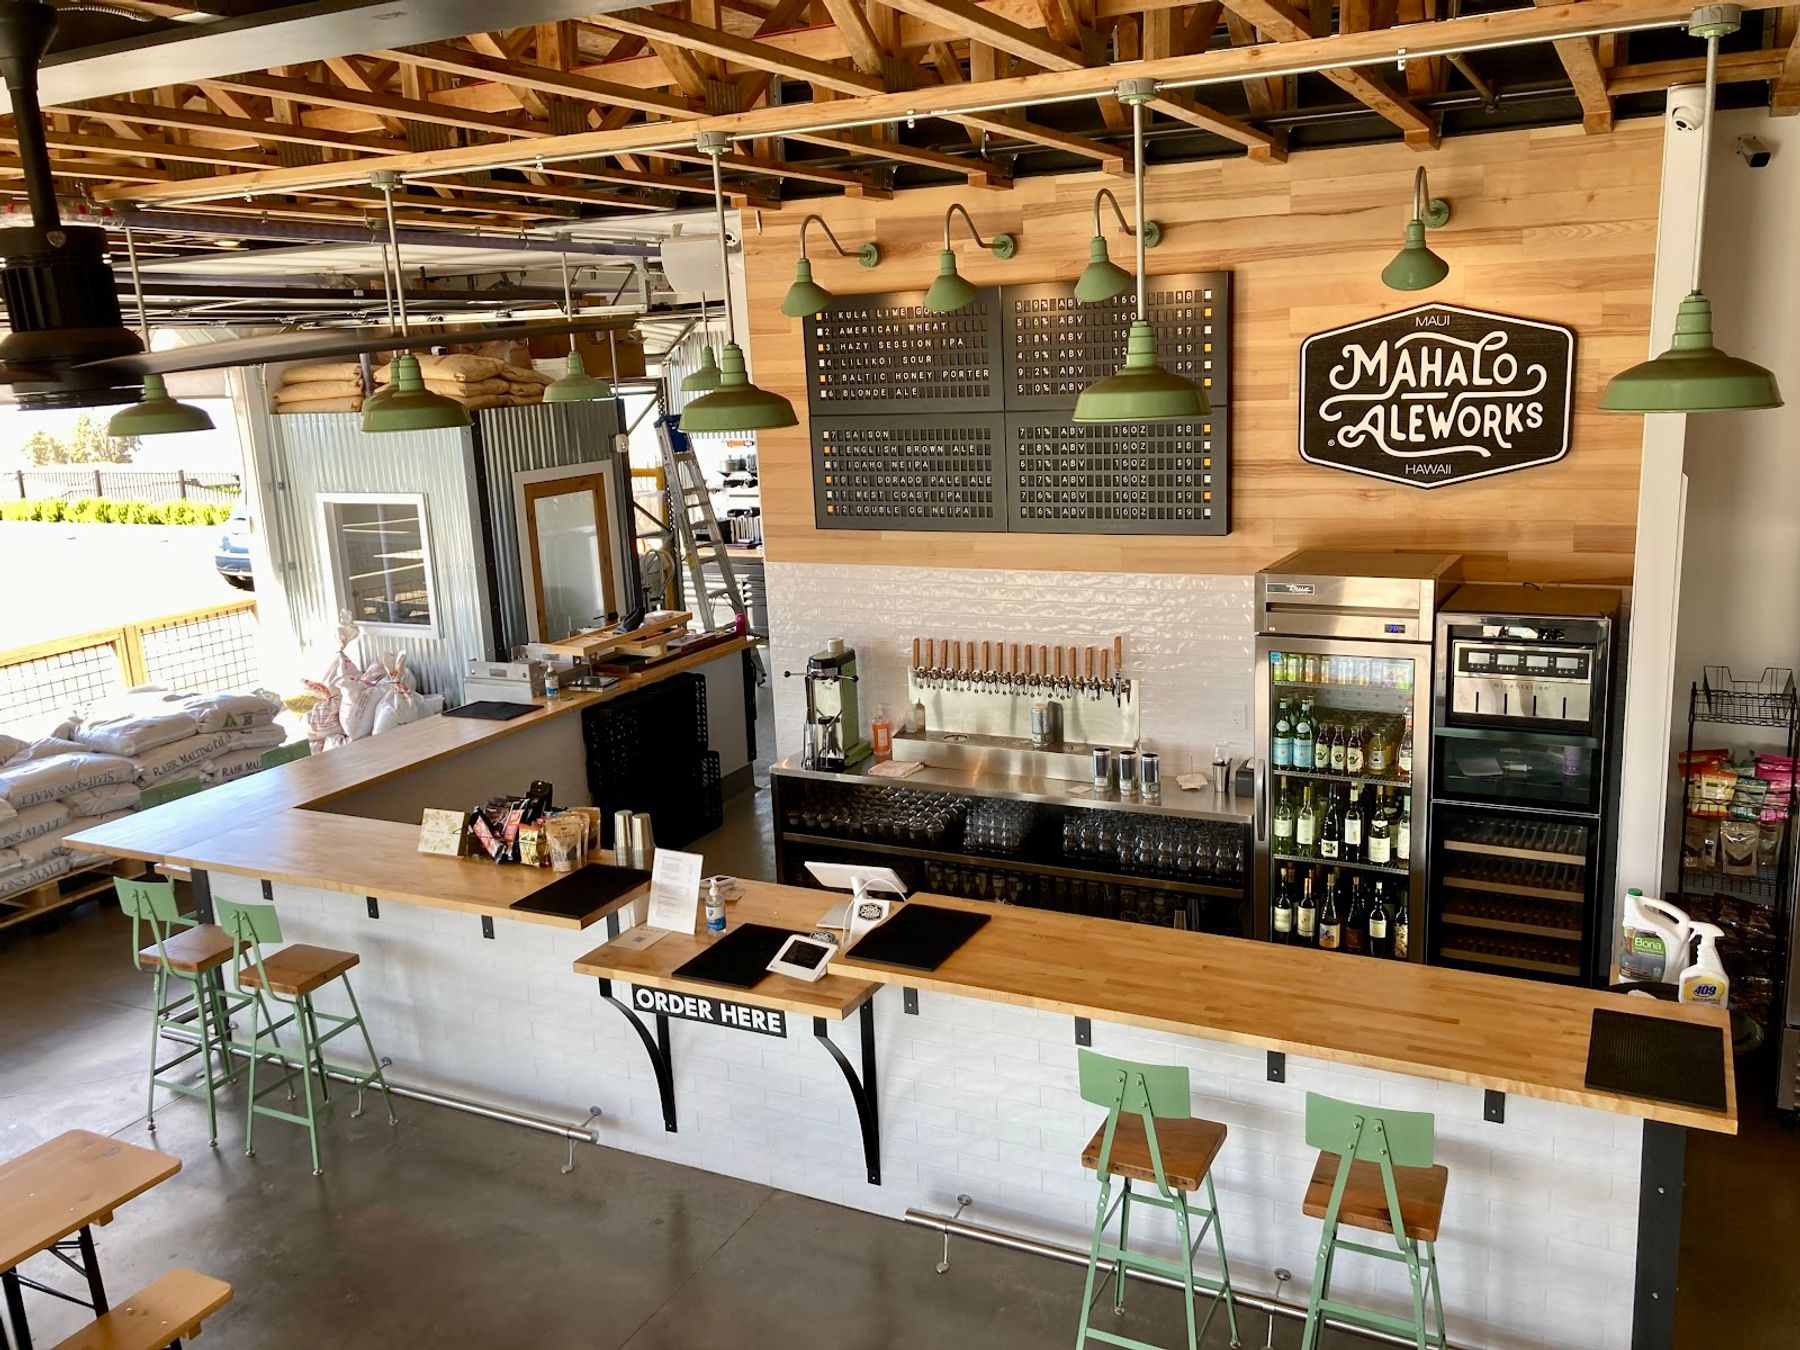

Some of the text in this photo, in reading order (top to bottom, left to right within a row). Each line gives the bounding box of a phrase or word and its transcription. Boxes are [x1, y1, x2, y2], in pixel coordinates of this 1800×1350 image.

[1177, 291, 1192, 299] $8
[877, 308, 906, 318] LIME
[1059, 315, 1083, 324] ABV
[1177, 309, 1192, 318] $8
[1416, 314, 1450, 327] MAUI
[840, 325, 899, 334] AMERICAN
[908, 322, 947, 331] WHEAT
[1059, 333, 1083, 341] ABV
[1177, 326, 1192, 335] $7
[878, 340, 932, 349] SESSION
[1060, 349, 1083, 358] ABV
[1177, 344, 1192, 352] $9
[1329, 331, 1518, 390] MAHALO
[1060, 366, 1083, 374] ABV
[1177, 361, 1192, 369] $9
[843, 389, 886, 397] BLONDE
[1060, 383, 1084, 391] ABV
[1177, 425, 1192, 433] $8
[1337, 401, 1544, 458] ALEWORKS
[1062, 459, 1084, 467] ABV
[1177, 458, 1192, 466] $9
[1405, 464, 1452, 475] HAWAII
[1062, 476, 1085, 484] ABV
[1177, 475, 1192, 483] $8
[1177, 508, 1192, 516] $9
[1635, 938, 1661, 950] Bona
[1694, 984, 1716, 997] 409
[636, 988, 781, 1032] ORDER HERE
